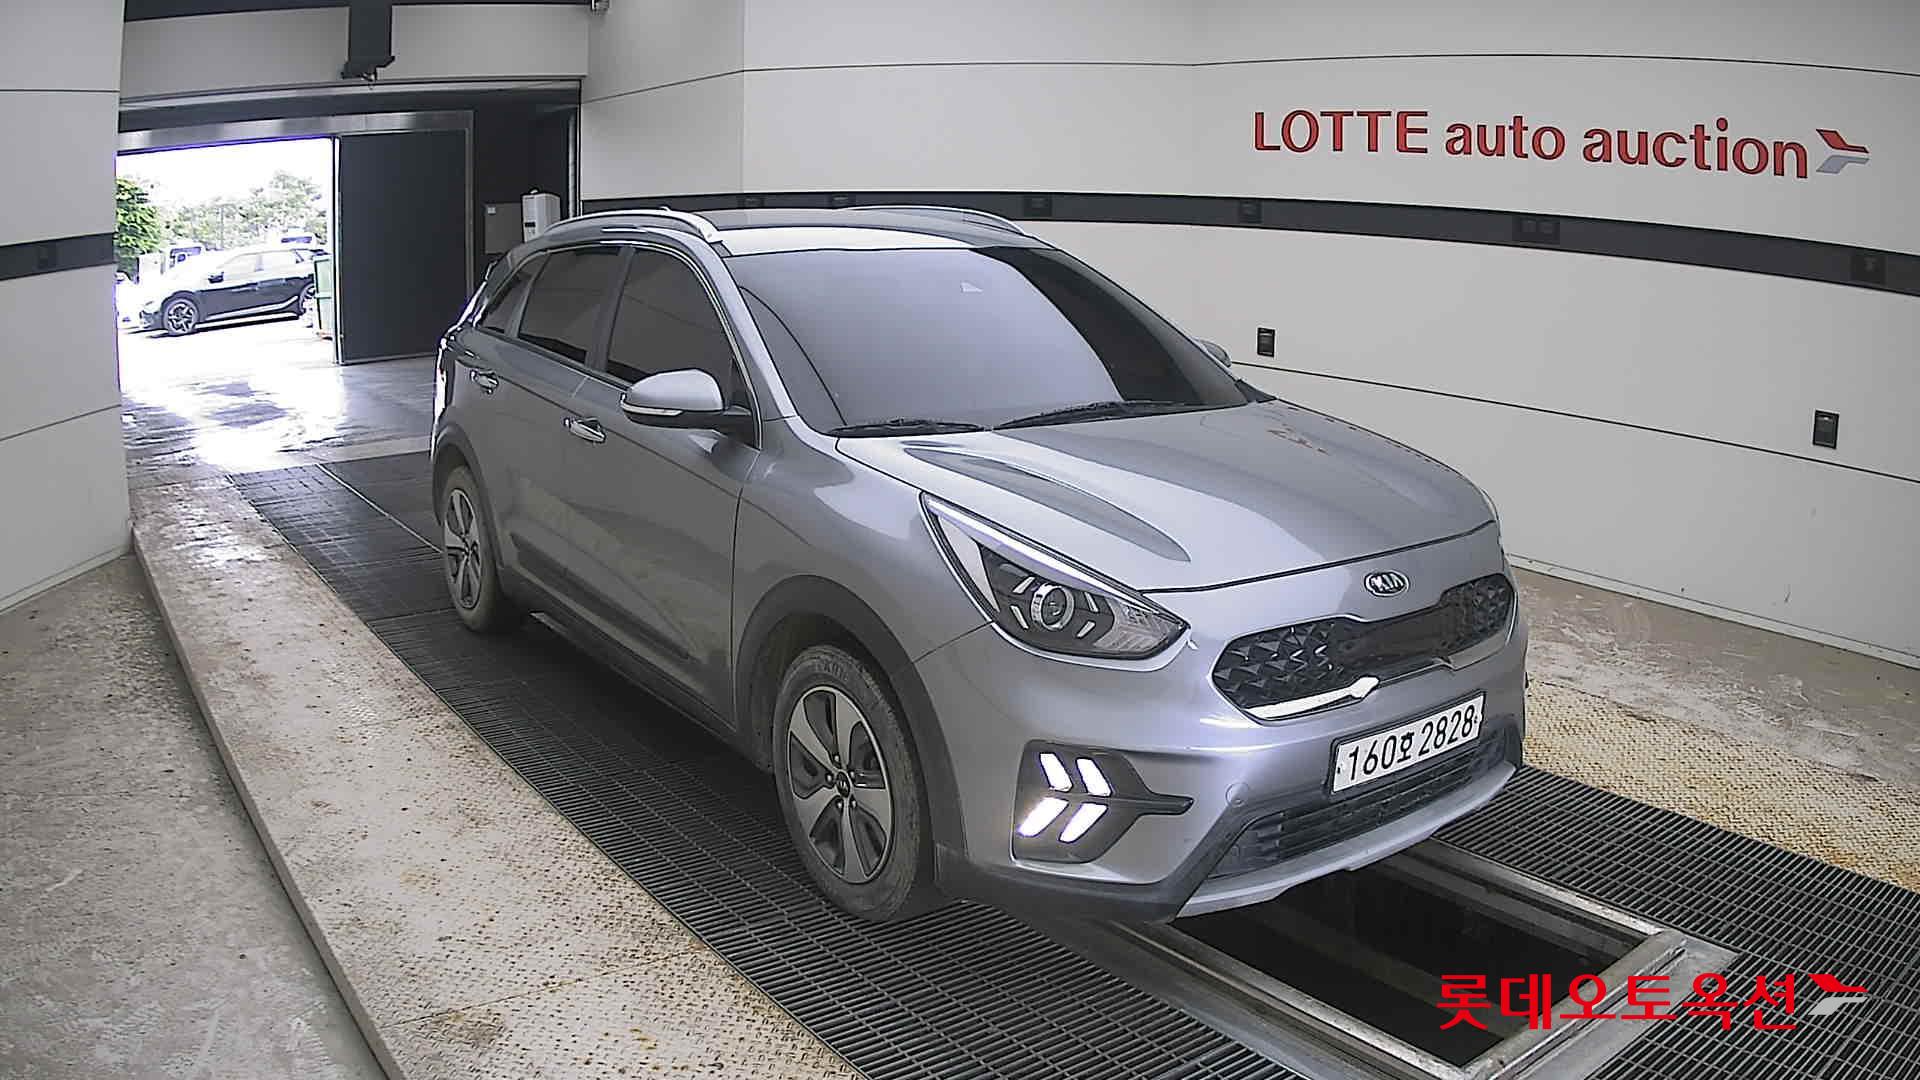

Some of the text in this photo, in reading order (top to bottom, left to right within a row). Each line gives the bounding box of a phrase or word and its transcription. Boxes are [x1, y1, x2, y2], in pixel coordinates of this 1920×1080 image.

[1254, 110, 1808, 179] LOTTE auto auction
[1418, 705, 1475, 757] 2828
